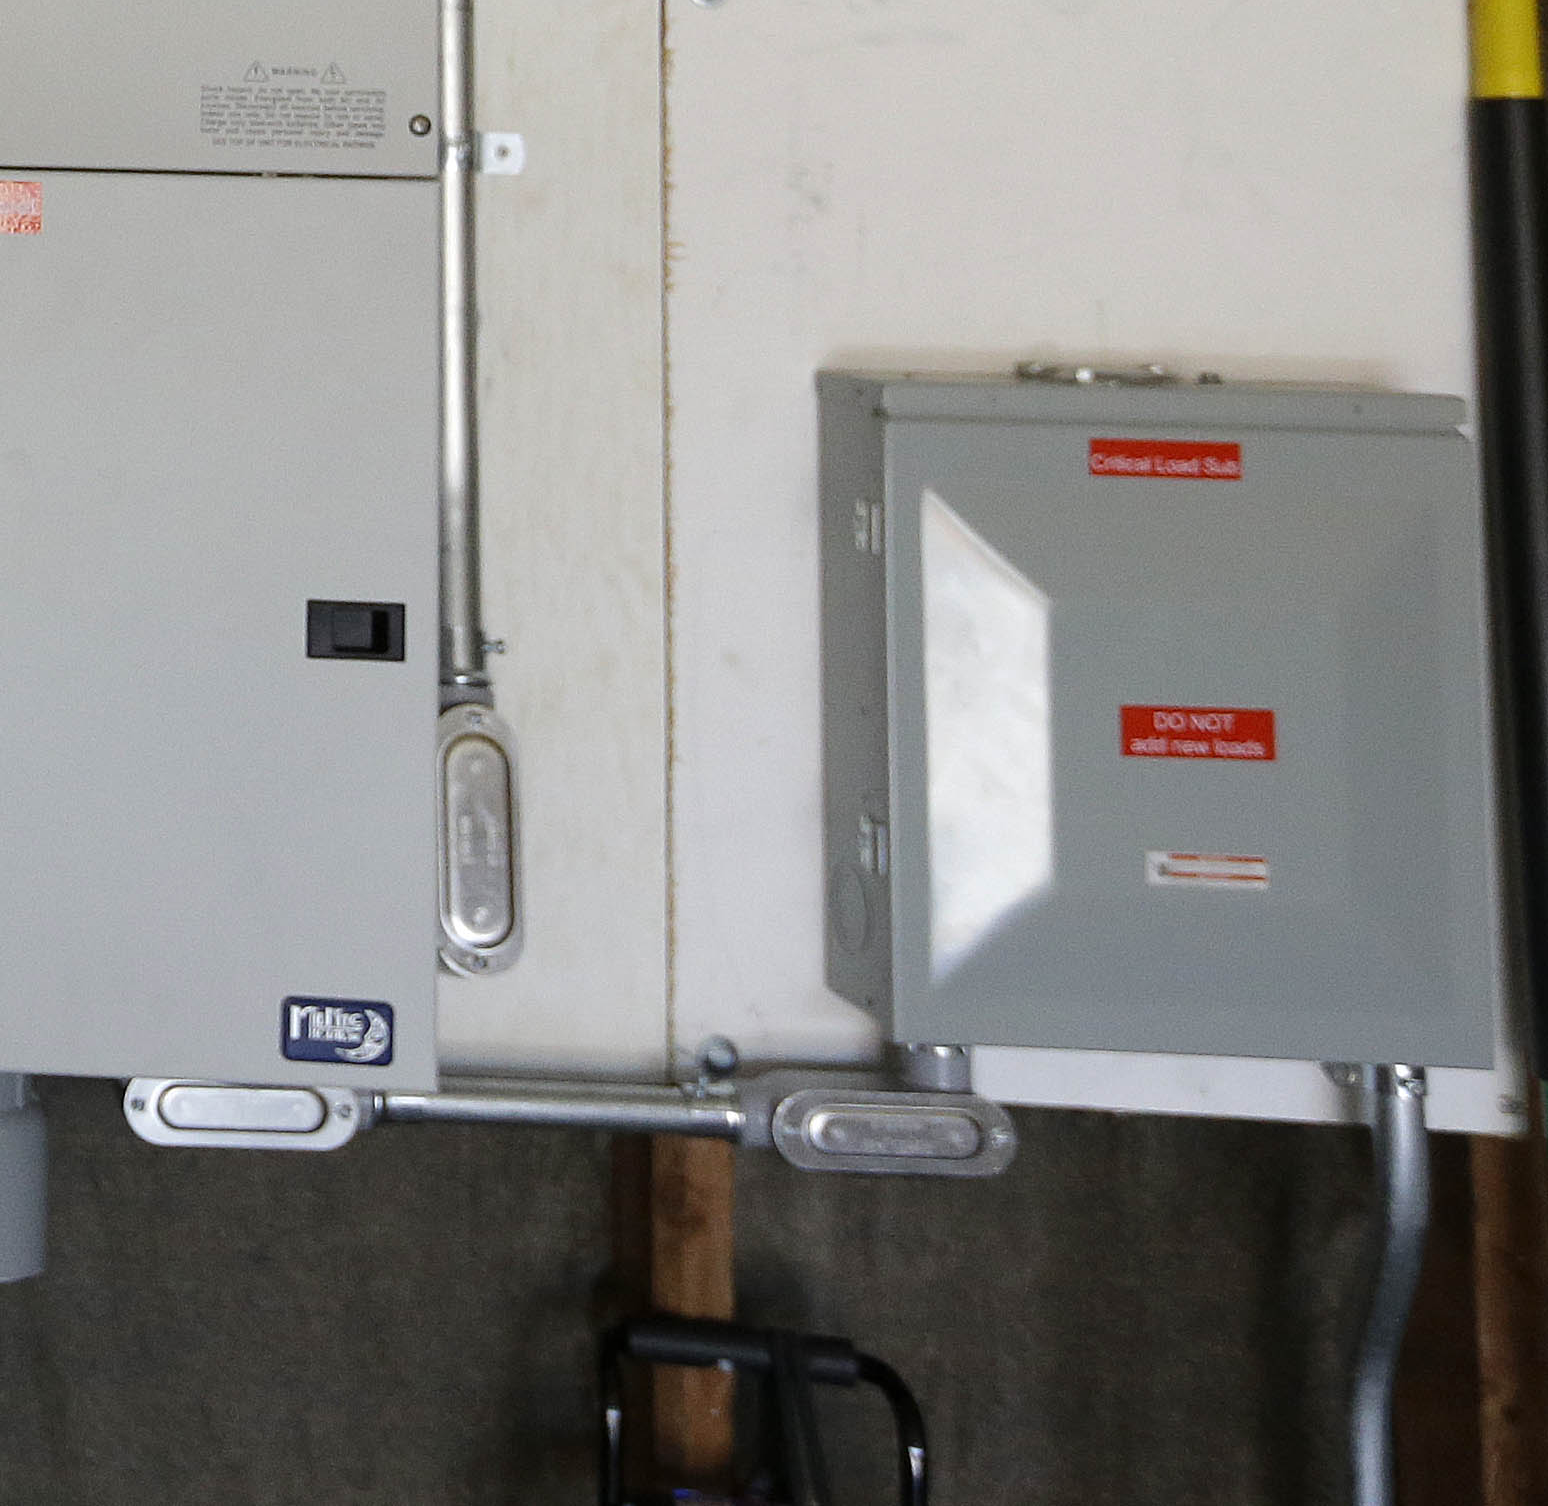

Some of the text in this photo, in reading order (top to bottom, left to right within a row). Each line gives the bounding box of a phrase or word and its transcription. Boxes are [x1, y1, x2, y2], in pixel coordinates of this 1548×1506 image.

[1153, 711, 1234, 734] DO NOT
[1130, 737, 1168, 754] add
